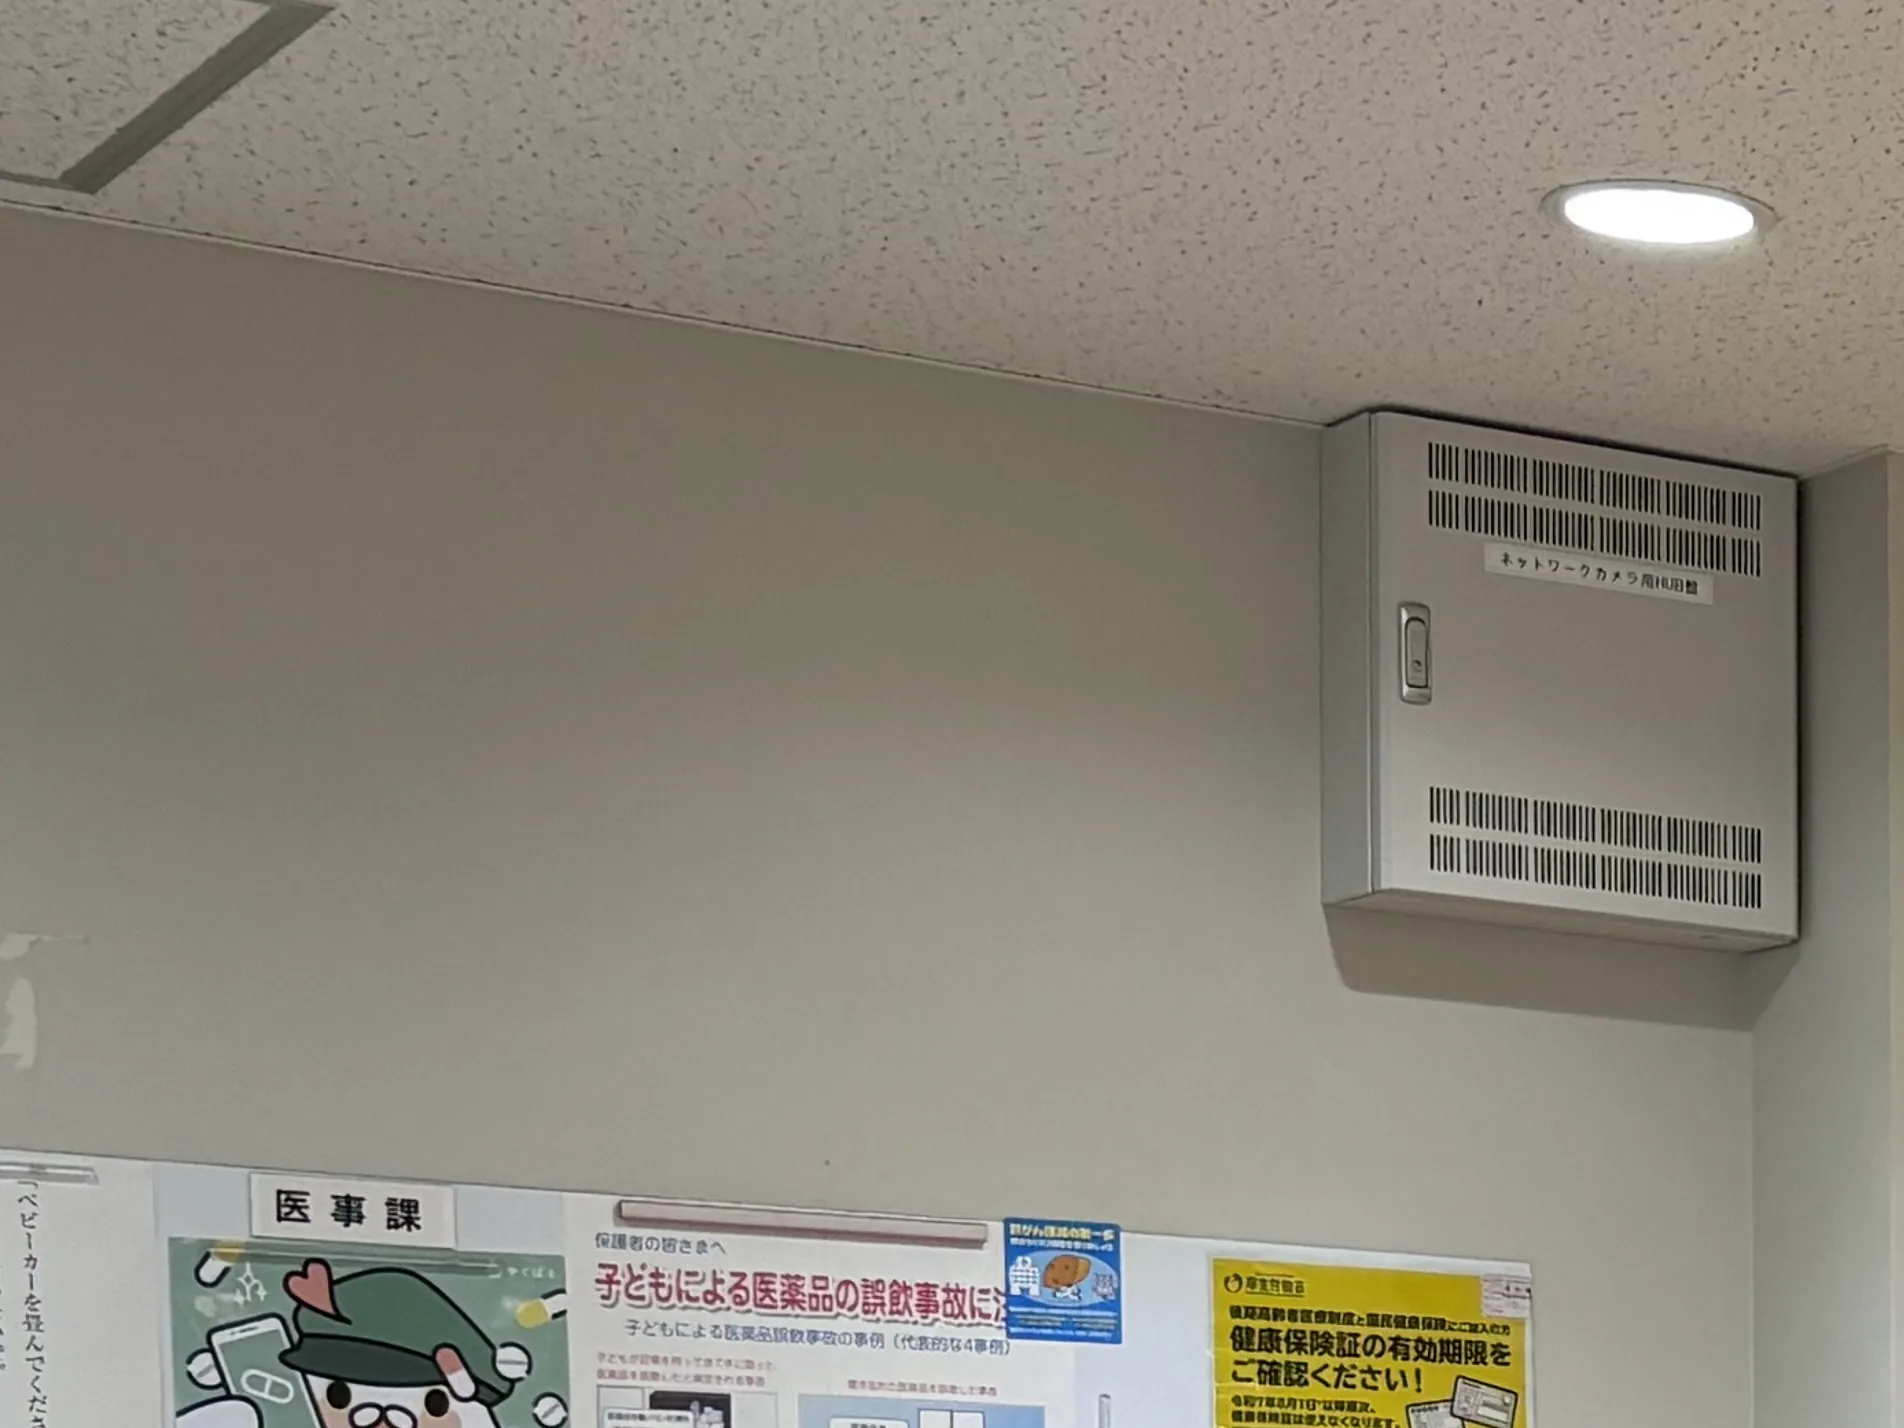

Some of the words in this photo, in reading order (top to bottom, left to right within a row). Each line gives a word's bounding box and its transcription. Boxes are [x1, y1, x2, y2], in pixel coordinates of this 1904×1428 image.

[275, 1189, 422, 1232] 医事課
[595, 1232, 727, 1255] 保護者の皆さまへ
[1230, 1325, 1512, 1367] 健康保険証の有効期限を
